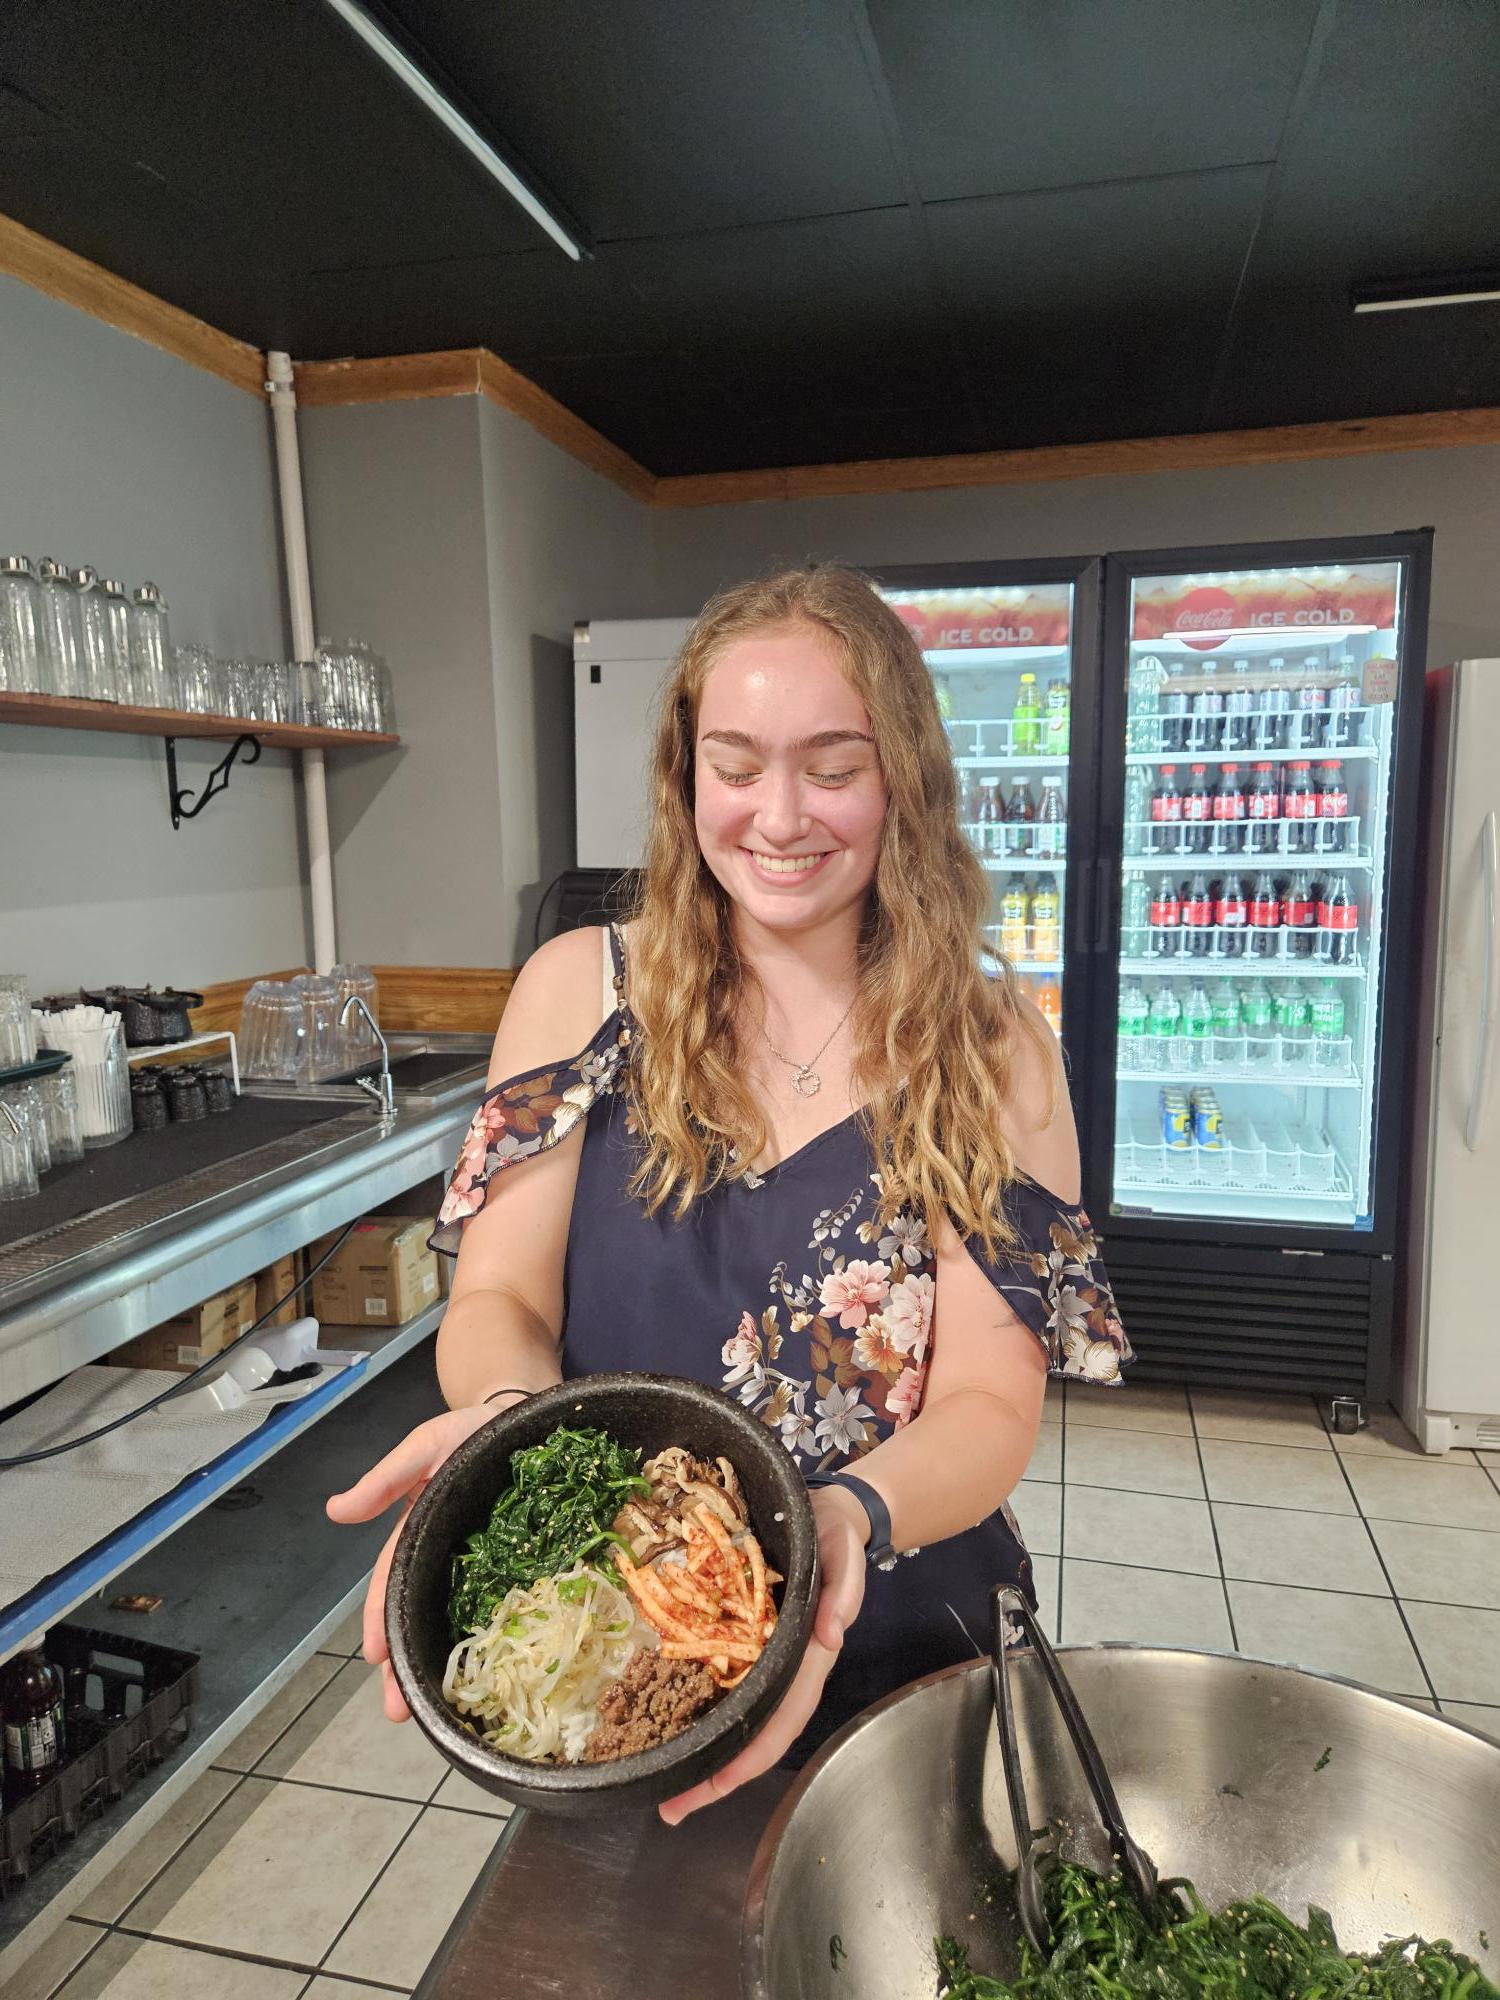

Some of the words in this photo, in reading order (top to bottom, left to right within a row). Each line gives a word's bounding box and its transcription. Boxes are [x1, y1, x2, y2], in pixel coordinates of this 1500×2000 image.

[1251, 612, 1286, 627] ICE
[1294, 608, 1355, 625] COLD
[940, 628, 972, 643] ICE
[979, 626, 1033, 643] COLD
